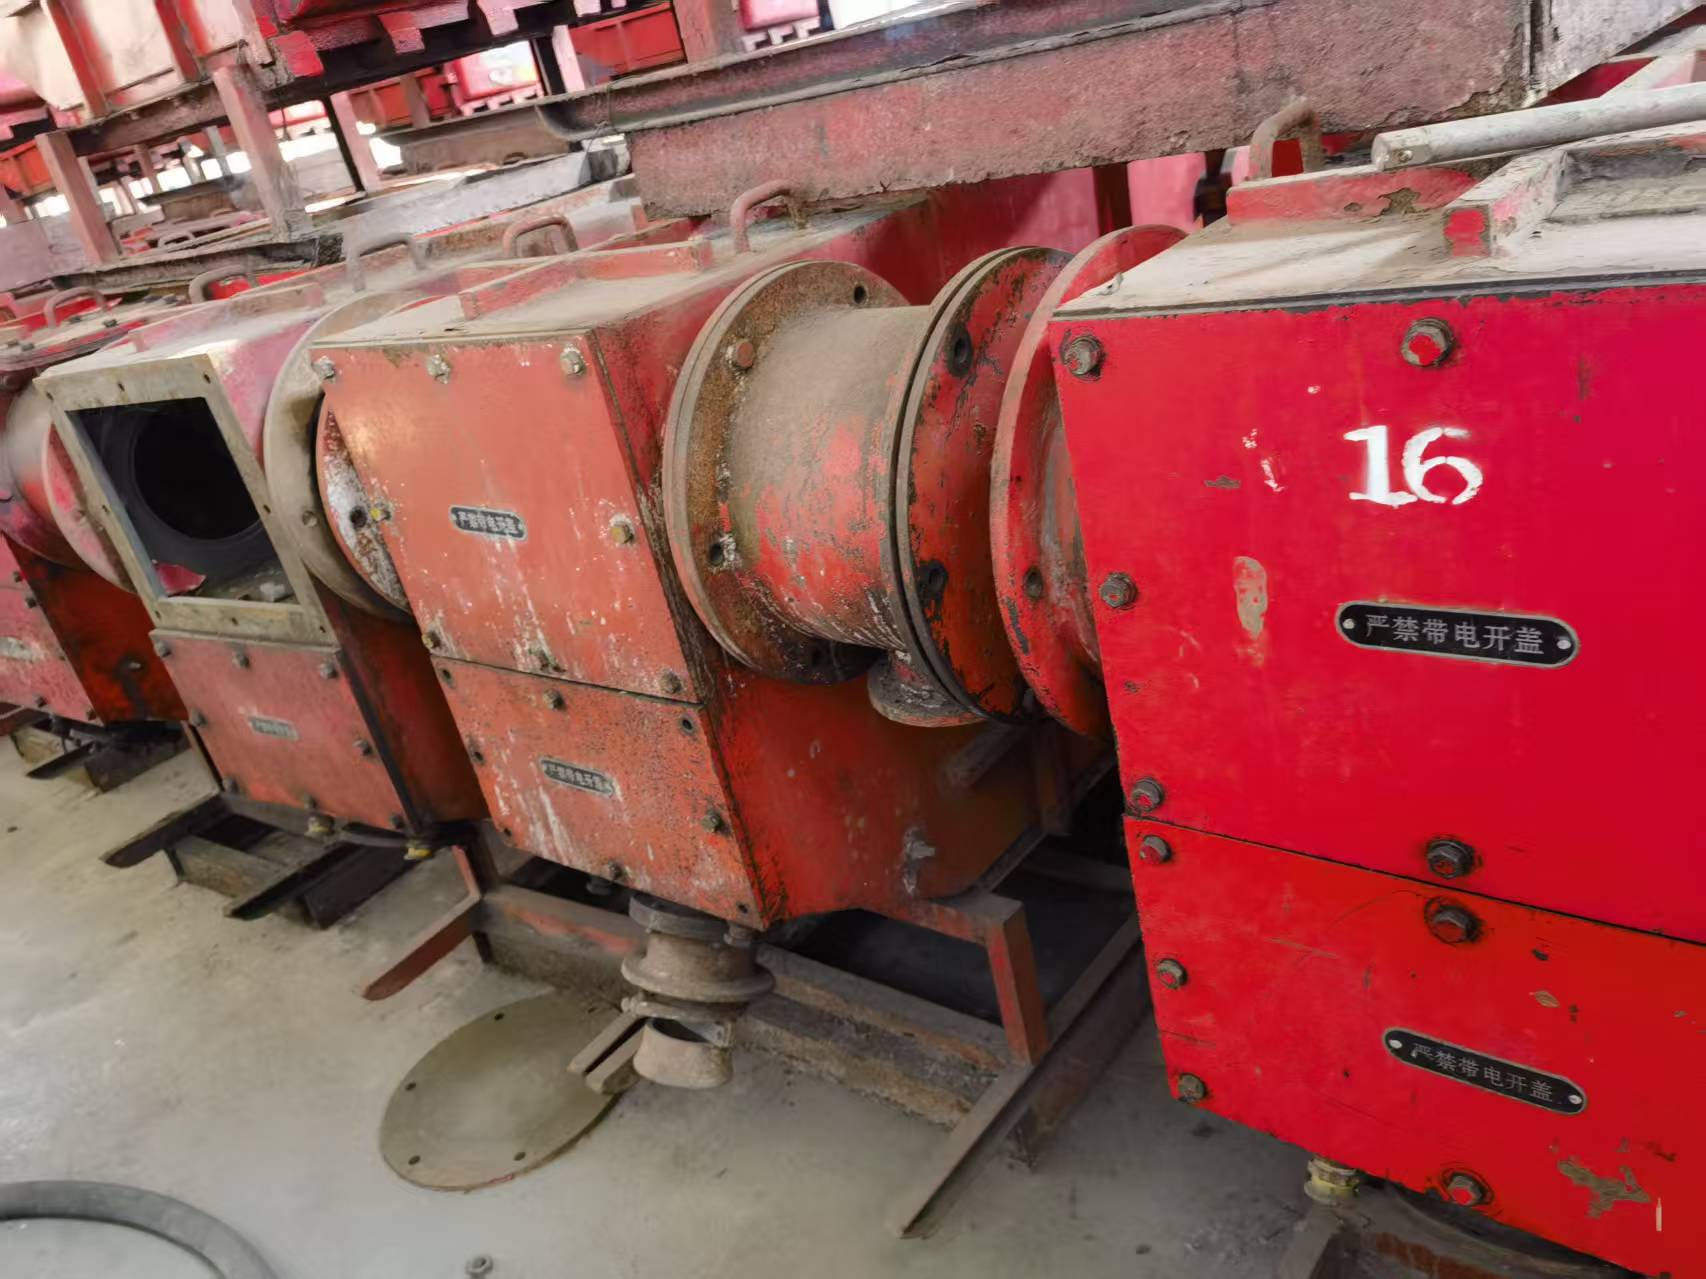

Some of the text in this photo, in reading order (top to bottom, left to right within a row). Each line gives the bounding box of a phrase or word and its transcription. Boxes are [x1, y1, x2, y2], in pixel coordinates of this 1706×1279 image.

[1343, 425, 1483, 508] 16
[1365, 613, 1545, 655] 严禁带电开盖
[1410, 1043, 1553, 1102] 严禁带电开盖
